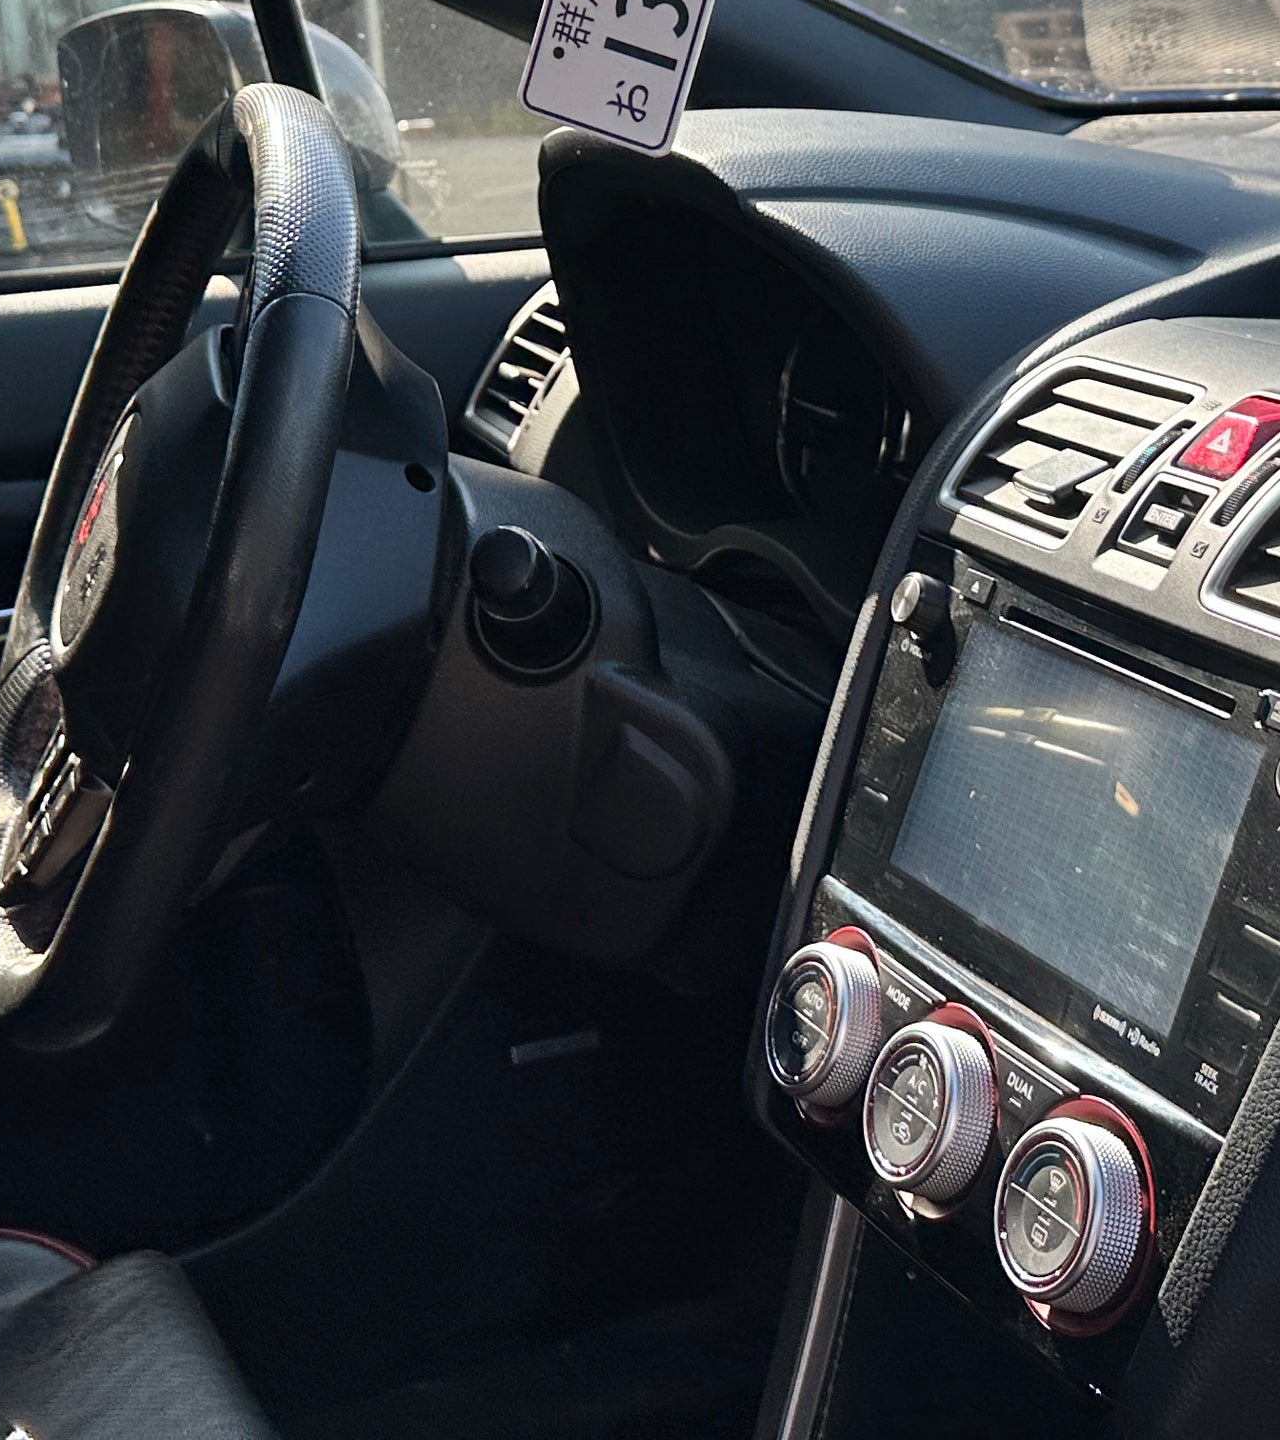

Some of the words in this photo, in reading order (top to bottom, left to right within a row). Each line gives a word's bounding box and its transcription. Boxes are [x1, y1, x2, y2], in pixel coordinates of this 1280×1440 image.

[607, 80, 650, 123] お
[801, 988, 824, 1010] AUTO
[886, 985, 912, 1011] MODE
[907, 1074, 928, 1096] A/C
[1006, 1071, 1034, 1100] DUAL
[1193, 1071, 1219, 1095] TRACK
